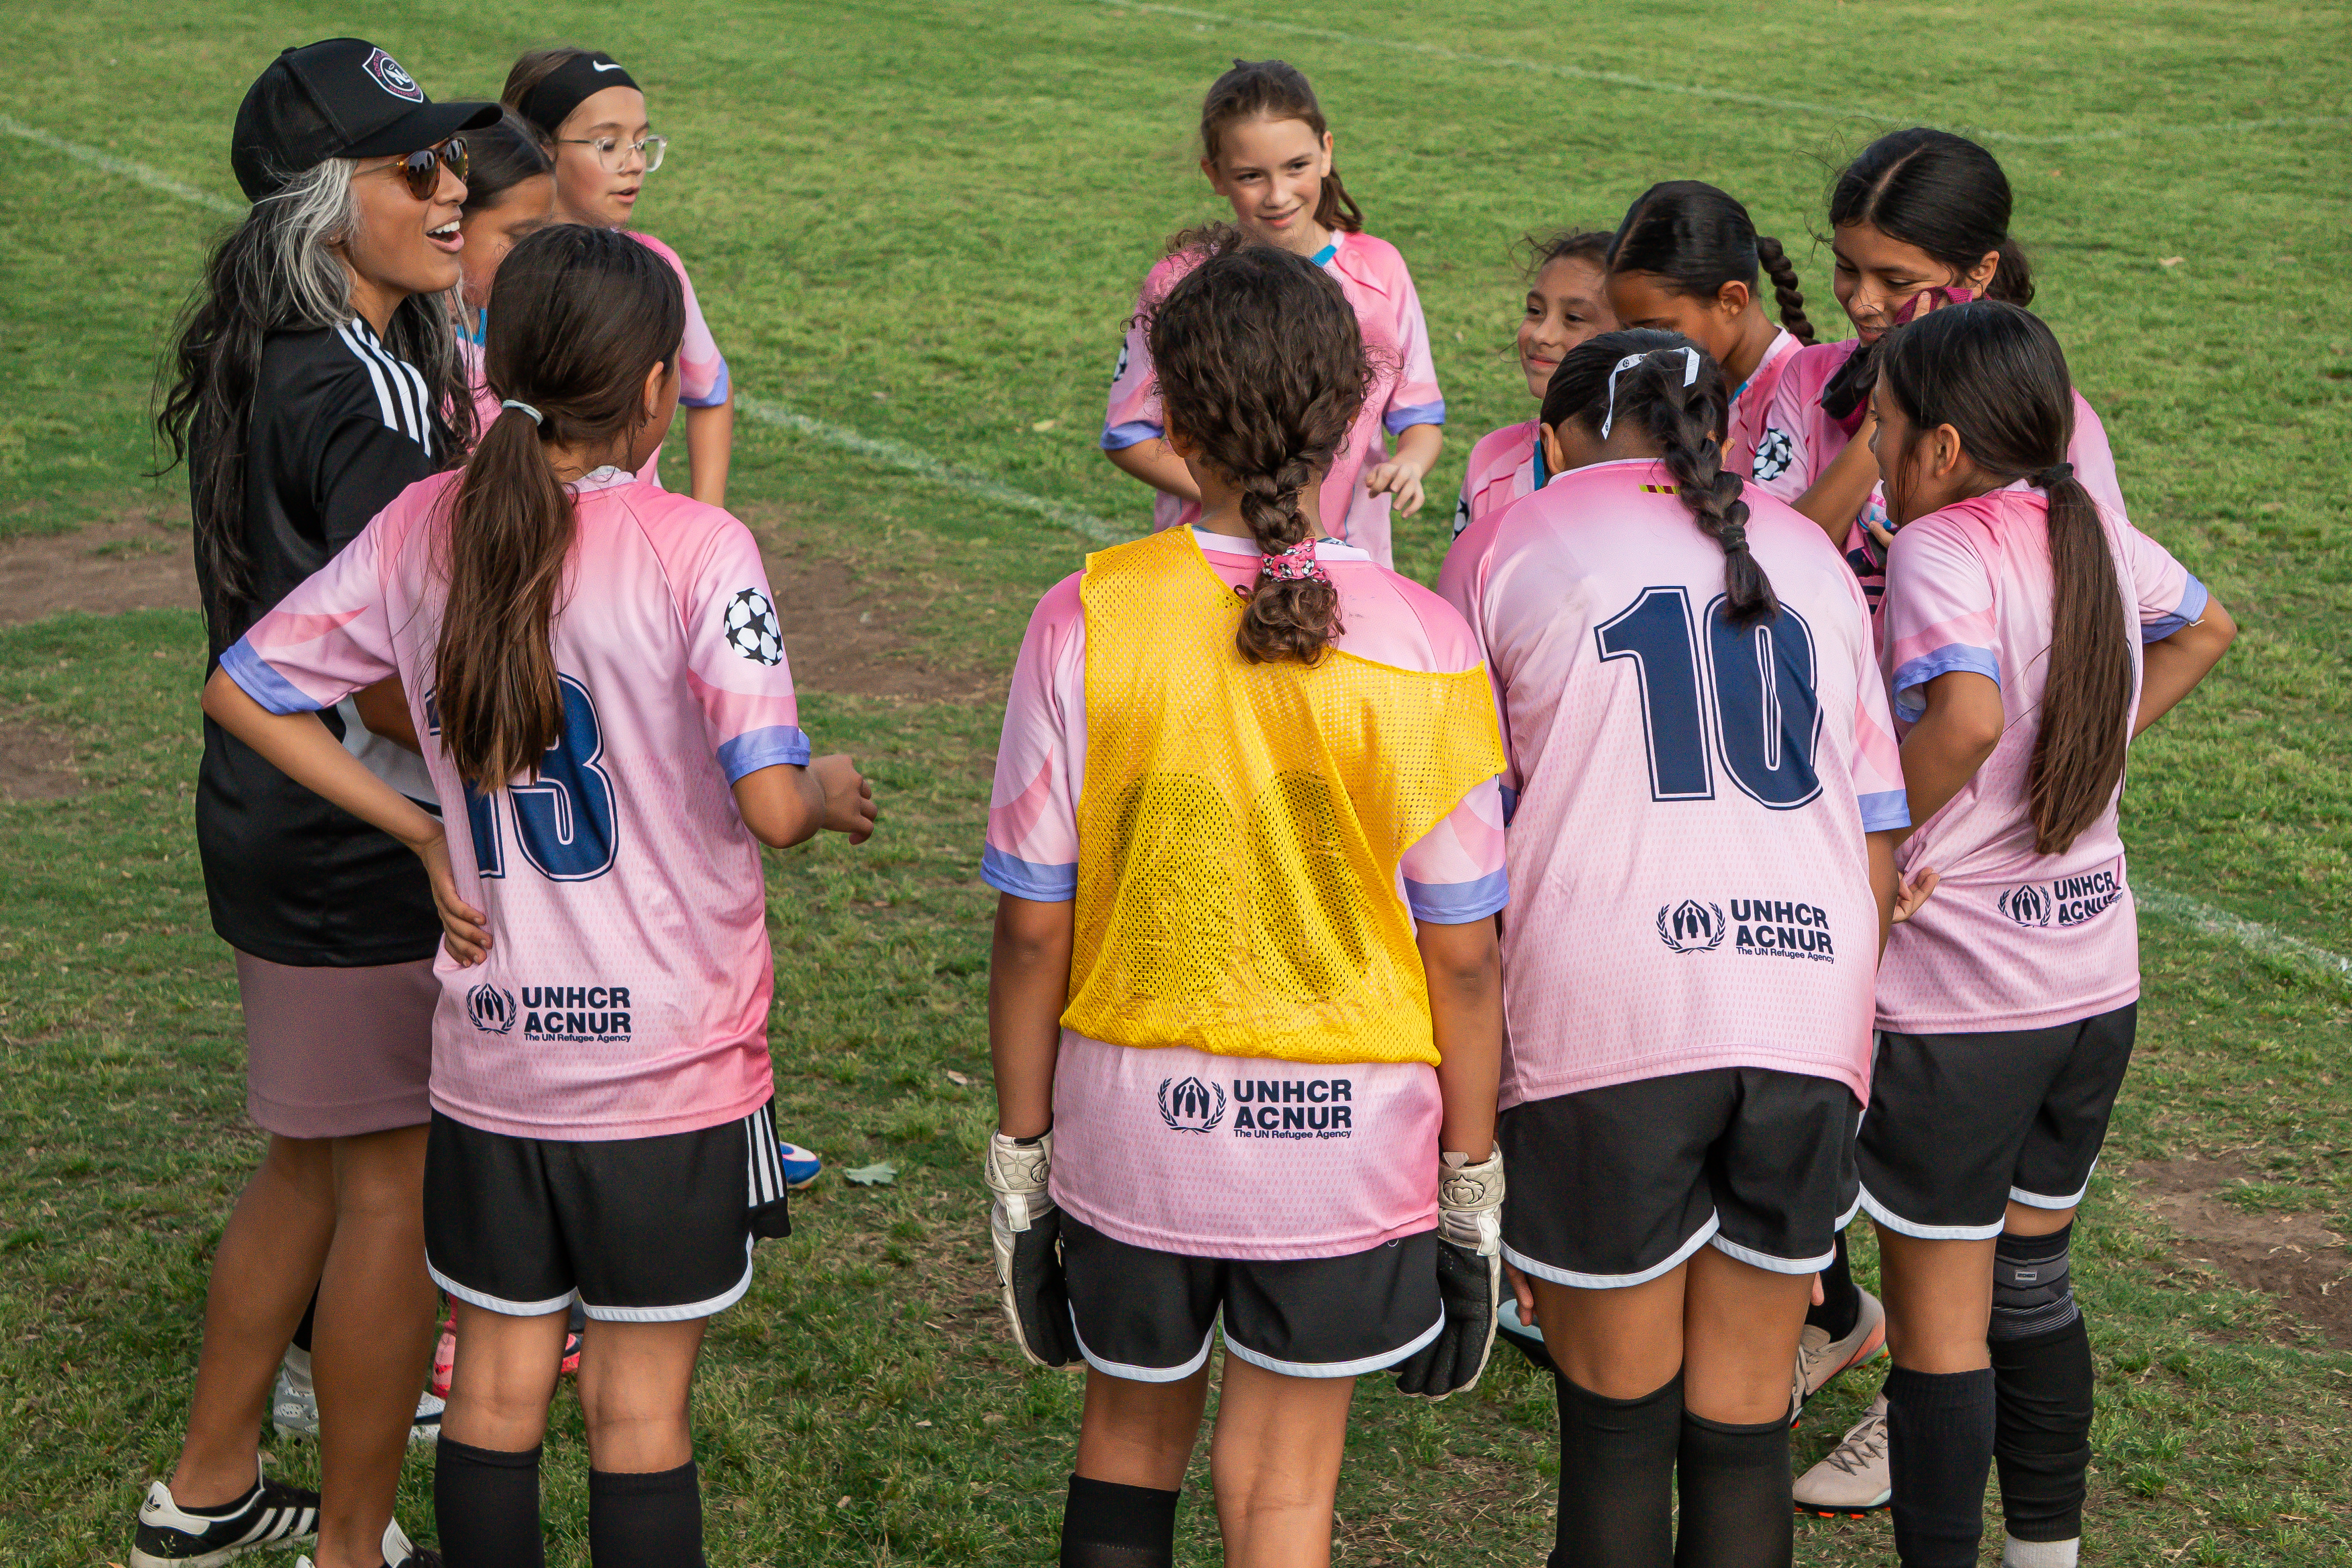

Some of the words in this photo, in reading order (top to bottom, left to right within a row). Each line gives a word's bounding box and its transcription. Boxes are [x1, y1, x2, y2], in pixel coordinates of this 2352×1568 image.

[1594, 585, 1823, 811] 10
[2053, 871, 2122, 901] UNHCR
[1730, 899, 1829, 930] UNHCR
[1735, 925, 1834, 955] ACNUR
[1736, 946, 1752, 955] The
[1754, 947, 1768, 955] UN
[1770, 948, 1805, 960] Refugee
[1807, 952, 1834, 964] Agency
[522, 987, 631, 1009] UNHCR
[524, 1011, 631, 1034] ACNUR
[524, 1033, 540, 1041] The
[542, 1033, 555, 1042] UN
[557, 1034, 595, 1043] Refugee
[597, 1034, 631, 1044] Agency
[1234, 1079, 1352, 1103] UNHCR
[1234, 1106, 1352, 1130] ACNUR
[1233, 1129, 1252, 1138] The
[1254, 1130, 1269, 1139] UN
[1272, 1130, 1313, 1140] Refugee
[1315, 1130, 1352, 1139] Agency
